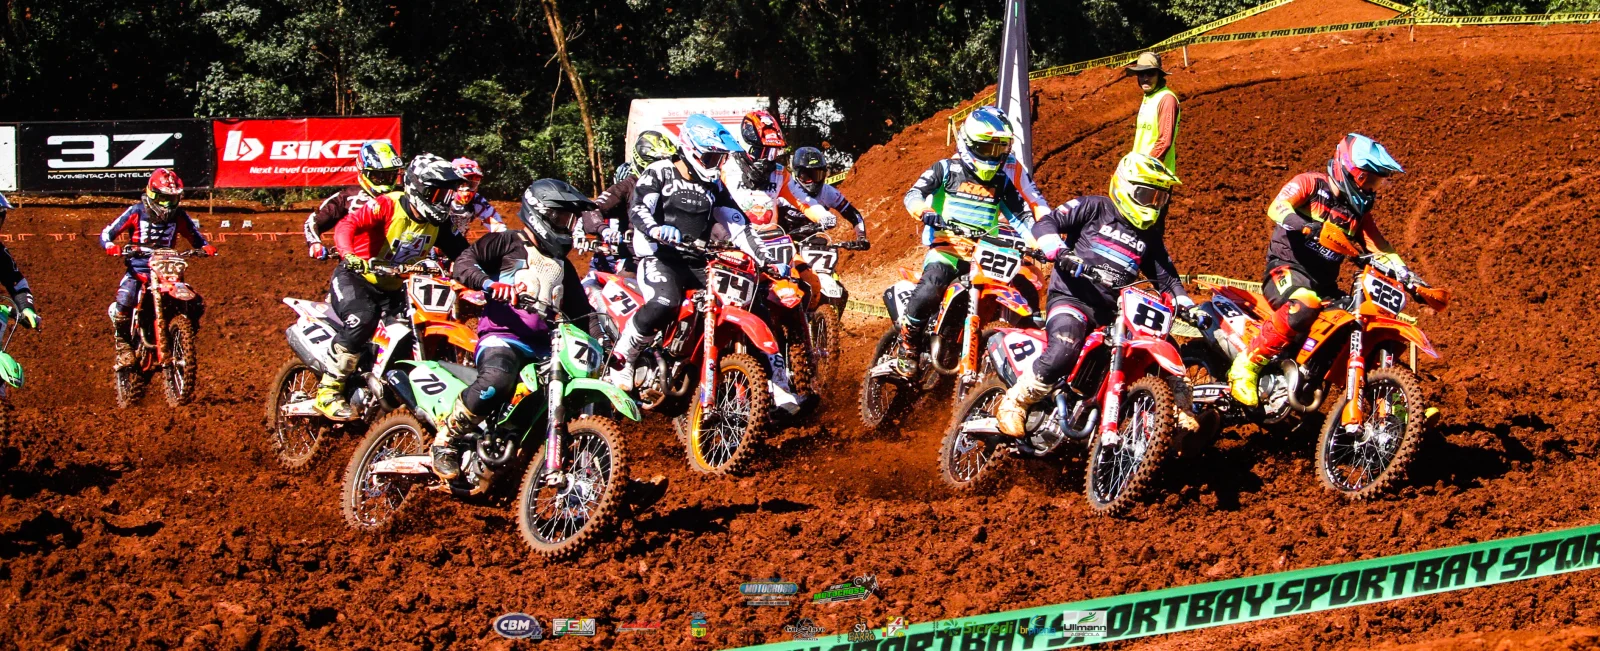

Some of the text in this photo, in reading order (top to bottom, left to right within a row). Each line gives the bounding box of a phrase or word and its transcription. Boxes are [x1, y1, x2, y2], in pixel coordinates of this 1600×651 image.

[1430, 16, 1454, 24] PRO
[1456, 15, 1484, 23] TORK
[1567, 12, 1591, 20] PRO
[1210, 33, 1231, 43] PRO
[1232, 30, 1257, 41] TORK
[1270, 28, 1290, 37] PRO
[1292, 25, 1316, 35] TORK
[1329, 22, 1349, 31] PRO
[1351, 19, 1375, 29] TORK
[1387, 17, 1407, 26] PRO
[48, 172, 116, 180] MOVIMENTAÇÃO
[250, 165, 358, 175] Next Level Componen
[807, 253, 834, 271] 71
[980, 250, 1018, 277] 227
[419, 284, 451, 306] 17
[1369, 279, 1403, 314] 323
[1133, 302, 1165, 330] 8
[302, 323, 332, 345] 17
[970, 319, 979, 366] DUNLOP
[573, 340, 599, 370] 70
[1008, 340, 1036, 362] 8
[412, 374, 447, 396] 70
[1275, 549, 1500, 616] SPORTBAY
